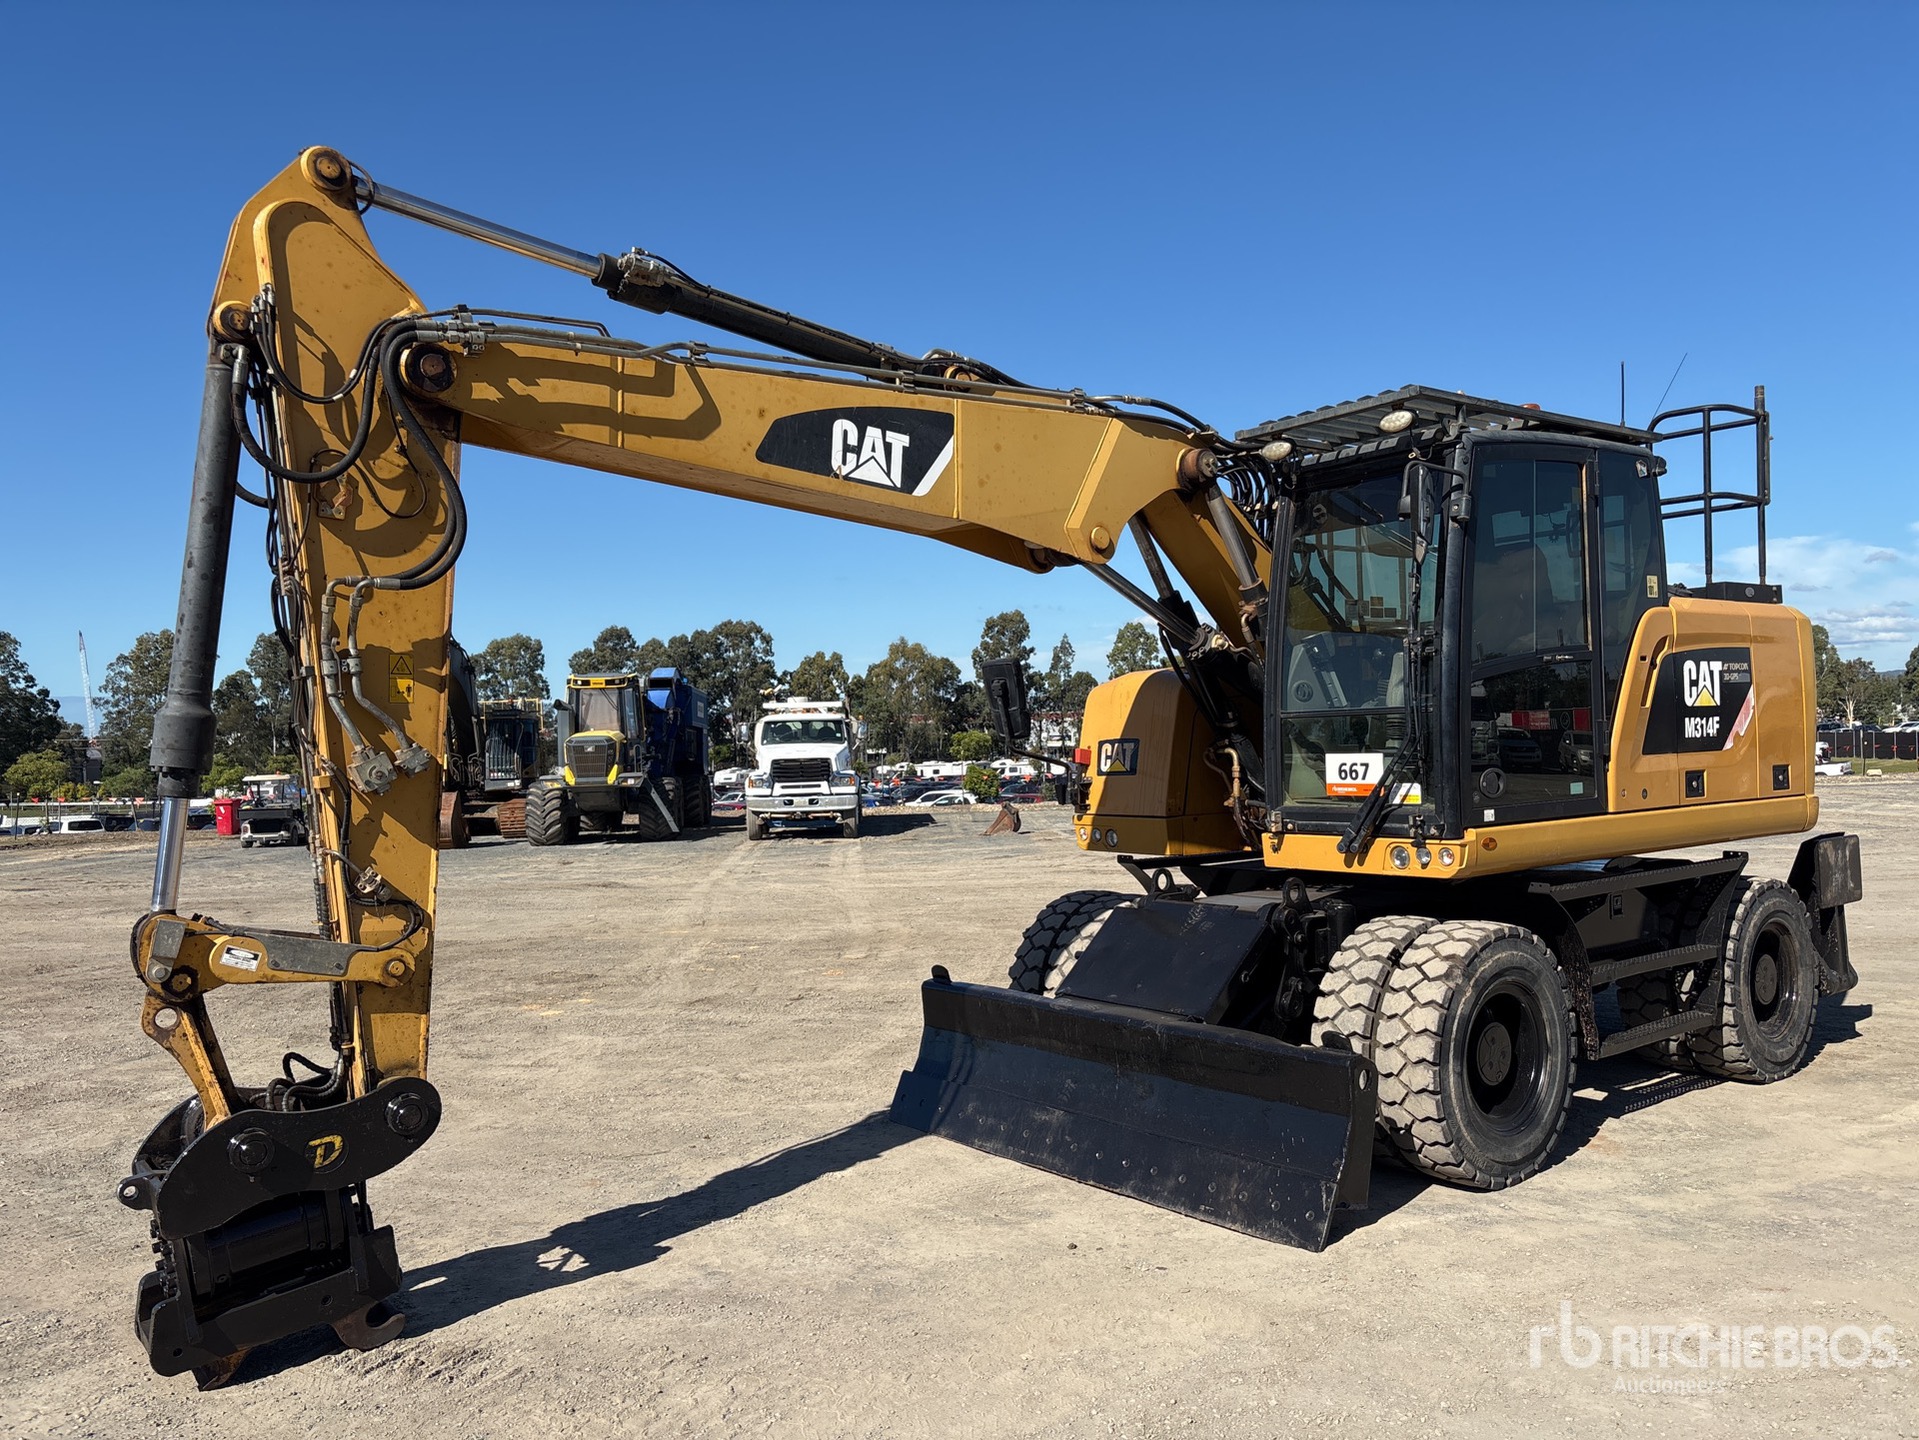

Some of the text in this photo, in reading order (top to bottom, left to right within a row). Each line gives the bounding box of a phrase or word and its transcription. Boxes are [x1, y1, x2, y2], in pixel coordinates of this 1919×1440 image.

[831, 419, 910, 488] CAT
[1683, 660, 1722, 707] CAT
[1685, 716, 1720, 738] M314F
[1100, 742, 1134, 772] CAT
[1338, 763, 1369, 780] 667
